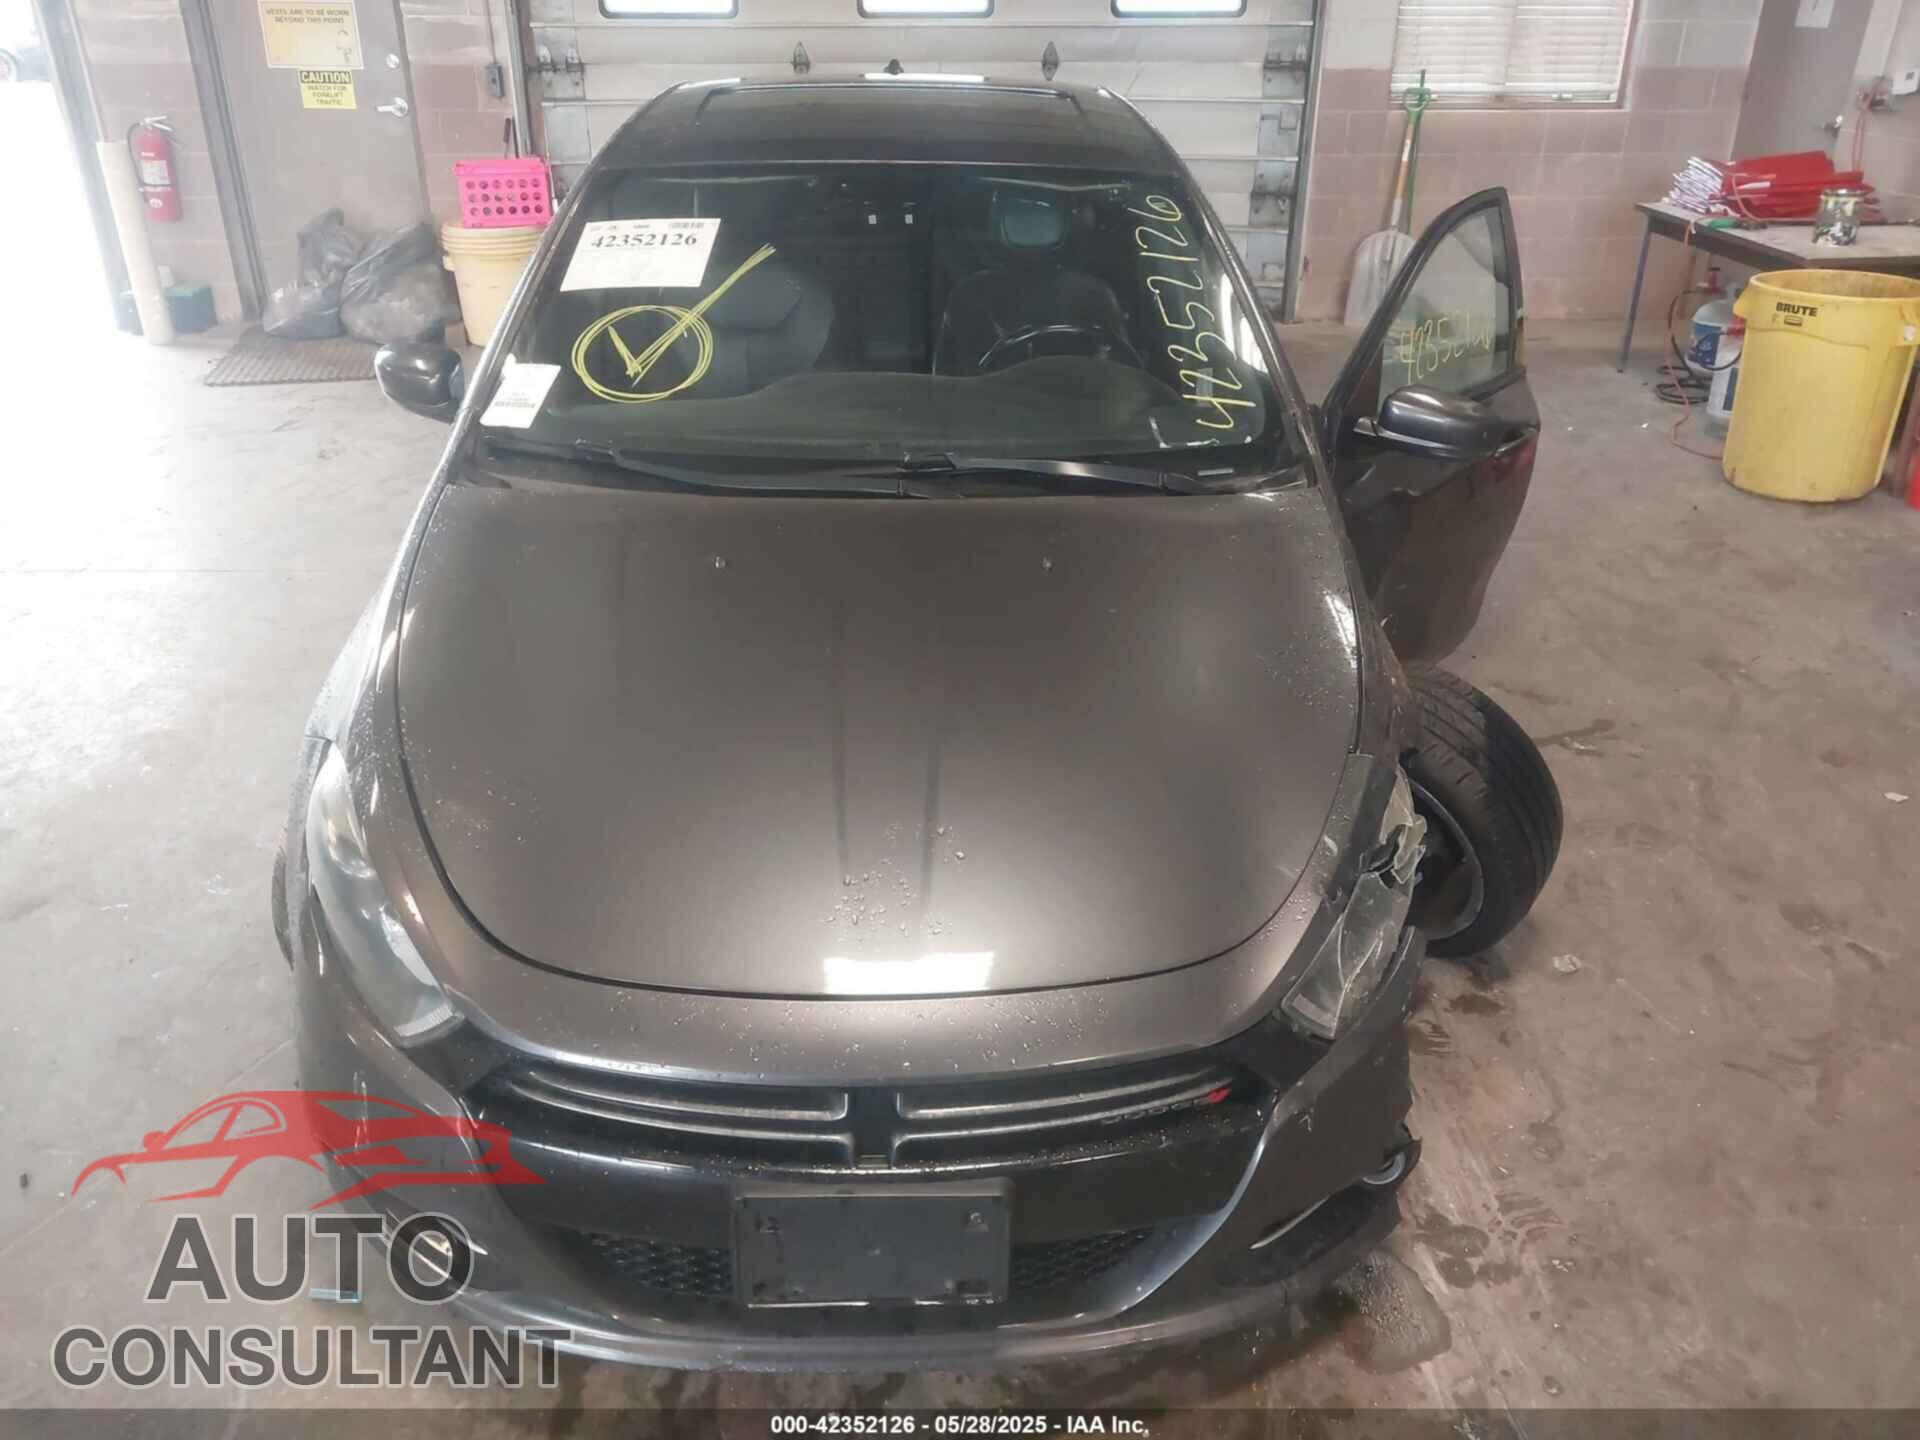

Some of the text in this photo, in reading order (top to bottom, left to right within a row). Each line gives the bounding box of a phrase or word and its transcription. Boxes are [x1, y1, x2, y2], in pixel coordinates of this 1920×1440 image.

[302, 71, 350, 83] CAUTION
[591, 232, 698, 249] 42352126
[1127, 195, 1256, 428] 42352126
[1775, 302, 1818, 317] BRUTE
